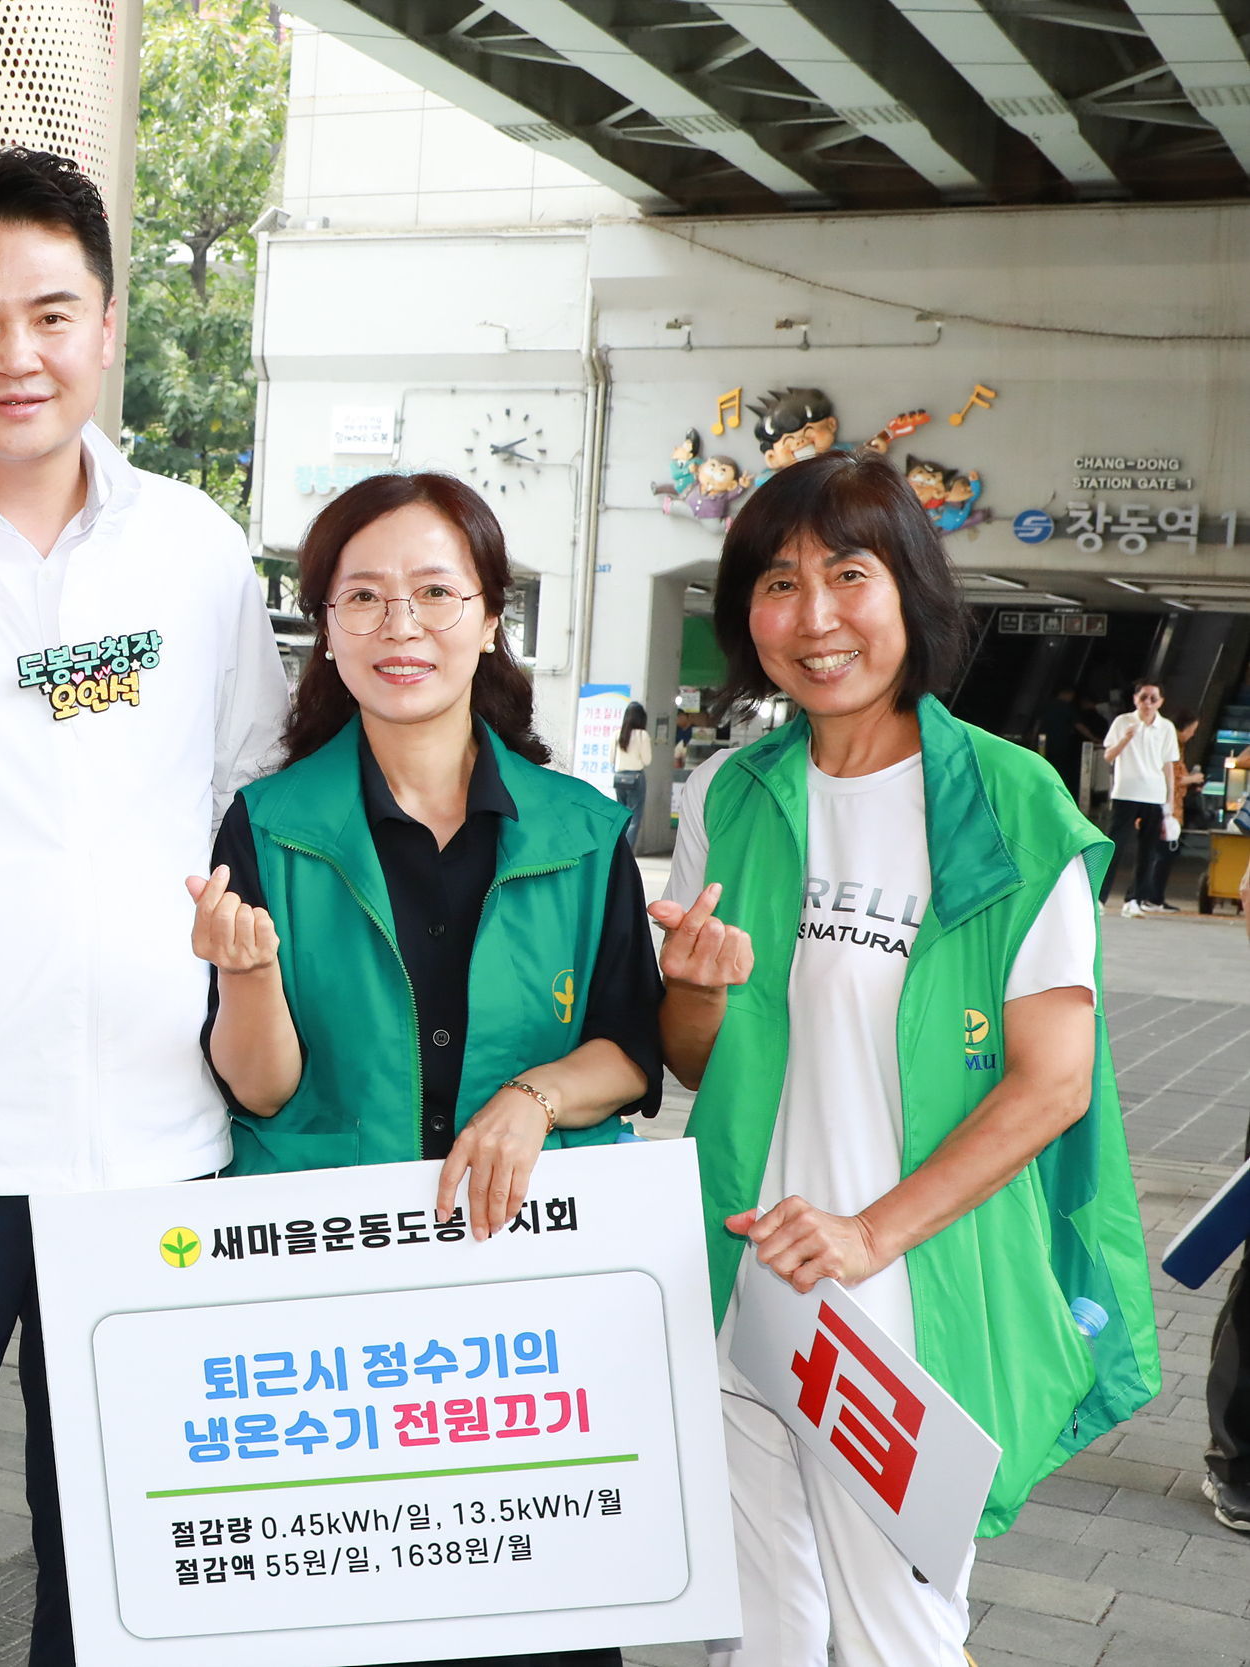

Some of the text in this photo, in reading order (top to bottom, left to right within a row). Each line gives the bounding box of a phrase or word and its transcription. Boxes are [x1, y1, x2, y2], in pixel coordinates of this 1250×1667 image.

[1072, 476, 1194, 490] STATION GATE 1
[1073, 457, 1180, 471] CHANG-DONG
[1065, 501, 1238, 556] 창동역 1
[18, 630, 162, 688] 도봉구청장
[50, 671, 140, 721] 오언석
[807, 923, 915, 959] NATURA
[211, 1196, 578, 1261] 새마을운동도봉지회
[203, 1328, 559, 1400] 퇴근시 정수기의
[184, 1387, 590, 1463] 냉온수기 전원끄기
[171, 1488, 623, 1548] 절감량 0.45kWh/일, 13.5kWh/월
[175, 1533, 532, 1586] 절감액 55원/일, 1638원/월
